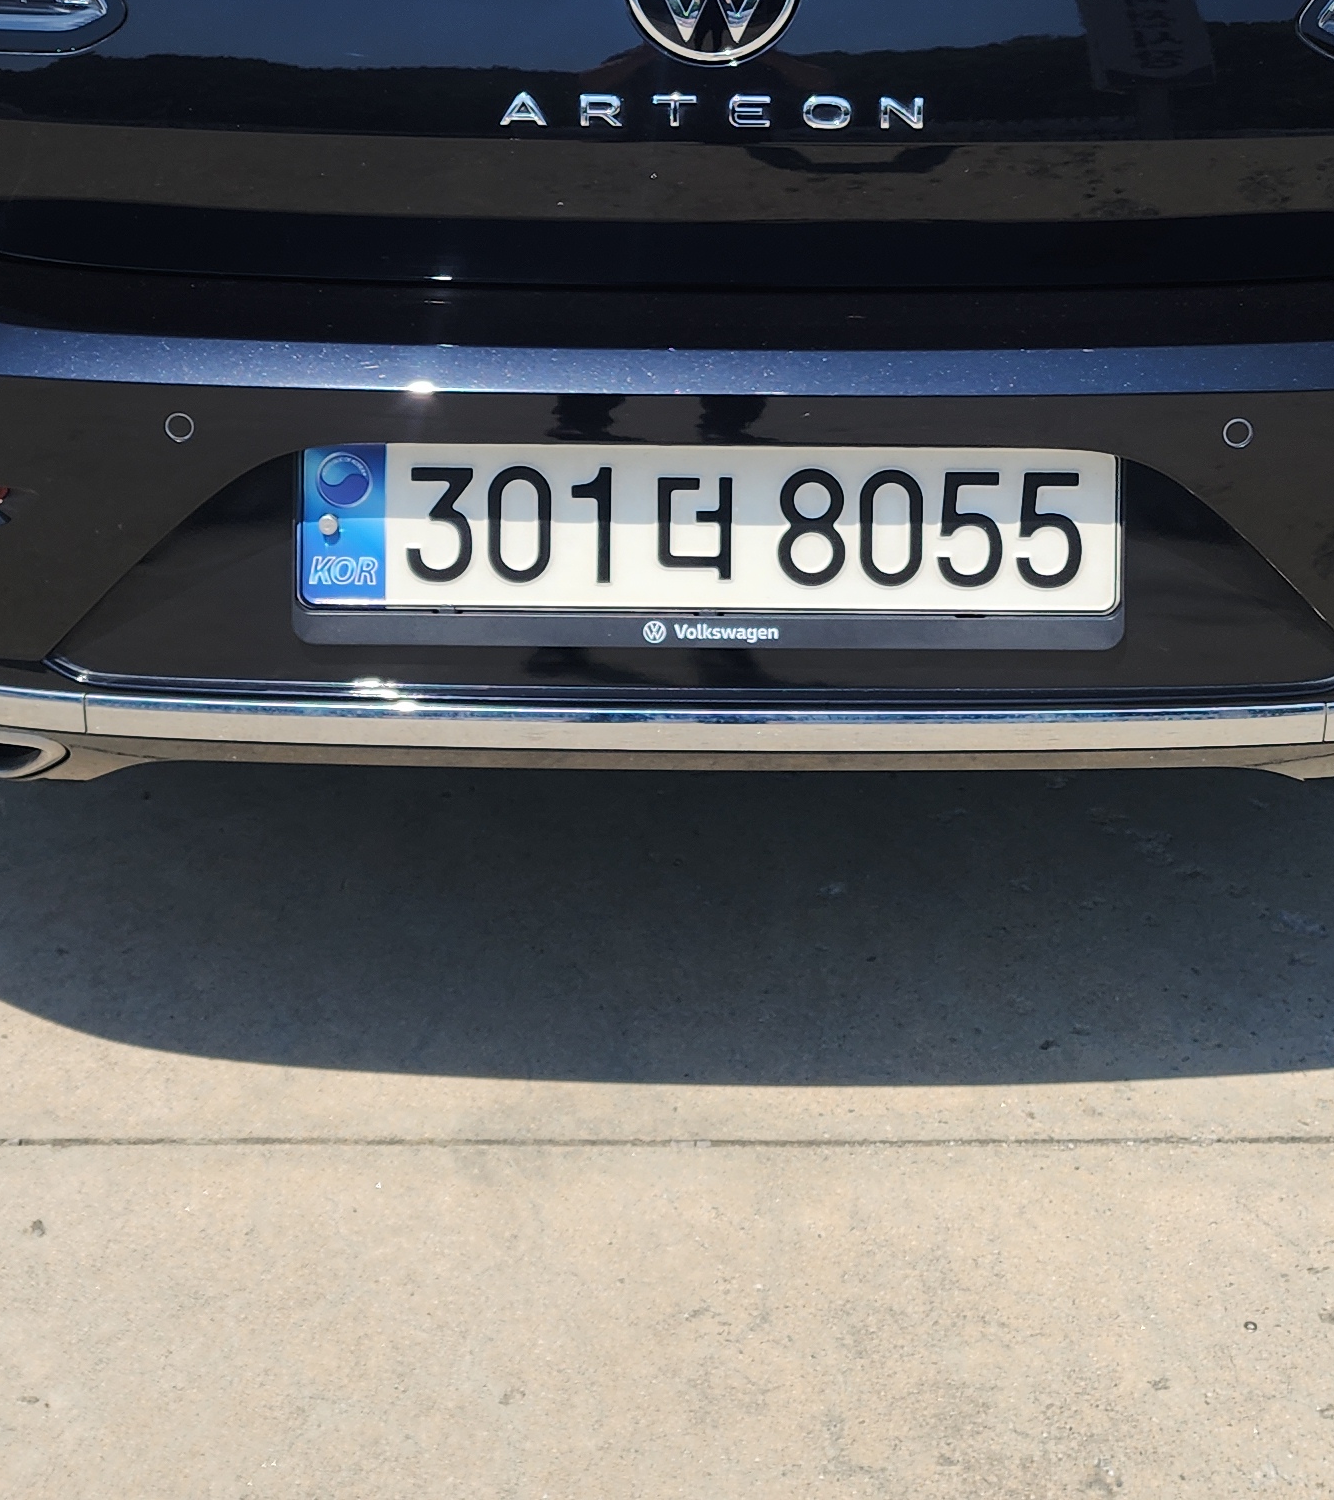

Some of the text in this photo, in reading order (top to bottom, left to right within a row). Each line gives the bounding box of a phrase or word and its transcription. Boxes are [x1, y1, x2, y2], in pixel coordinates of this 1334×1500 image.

[499, 90, 925, 130] ARTEON
[308, 555, 378, 585] KOR
[673, 623, 780, 644] Volkswagen
